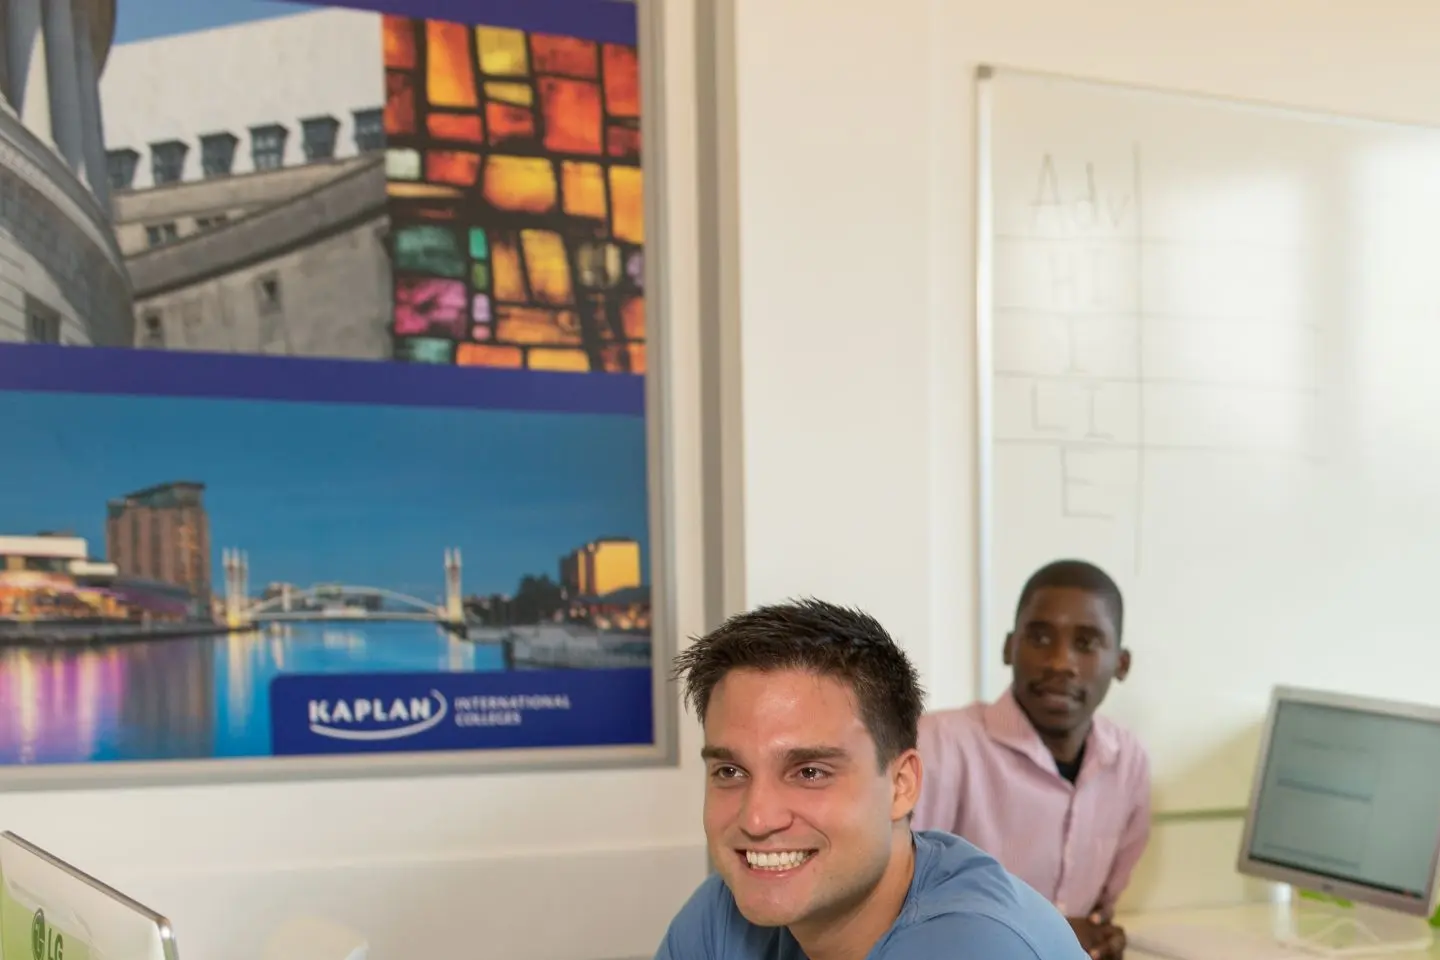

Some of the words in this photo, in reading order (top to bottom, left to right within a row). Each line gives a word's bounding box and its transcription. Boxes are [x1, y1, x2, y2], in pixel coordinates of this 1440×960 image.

[1059, 445, 1114, 520] E
[308, 697, 432, 723] KAPLAN
[454, 695, 571, 710] INTERNATIONAL
[454, 711, 522, 727] COLLEGES
